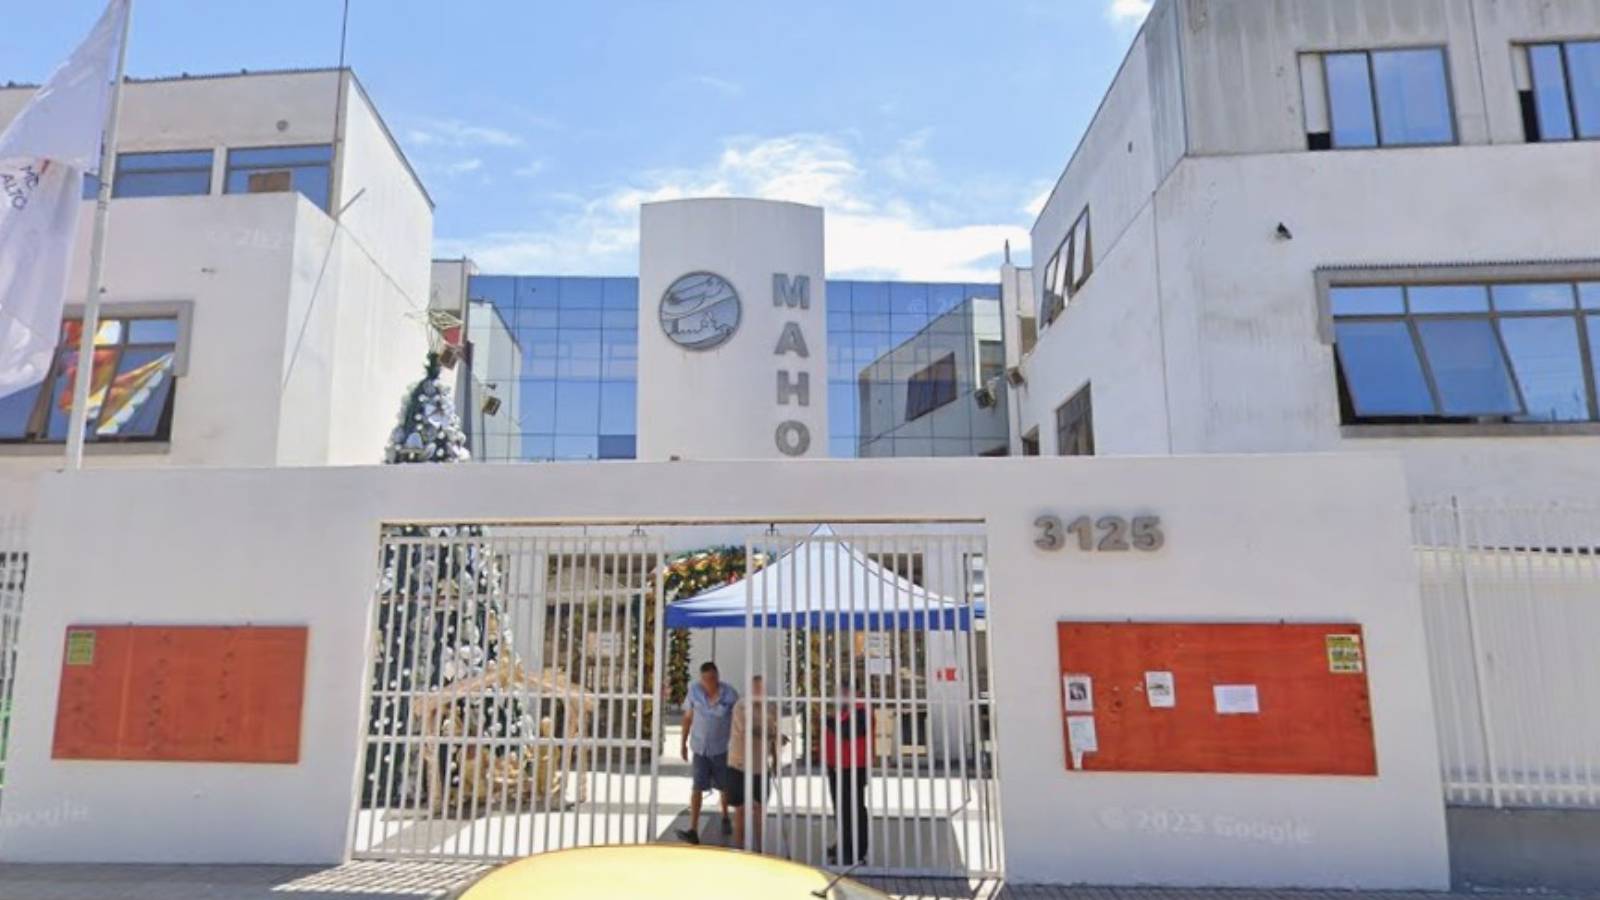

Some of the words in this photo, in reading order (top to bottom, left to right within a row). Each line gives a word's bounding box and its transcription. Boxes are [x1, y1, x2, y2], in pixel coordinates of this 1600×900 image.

[1, 173, 28, 211] ALTO
[771, 272, 811, 457] MAHO
[1033, 515, 1165, 552] 3125
